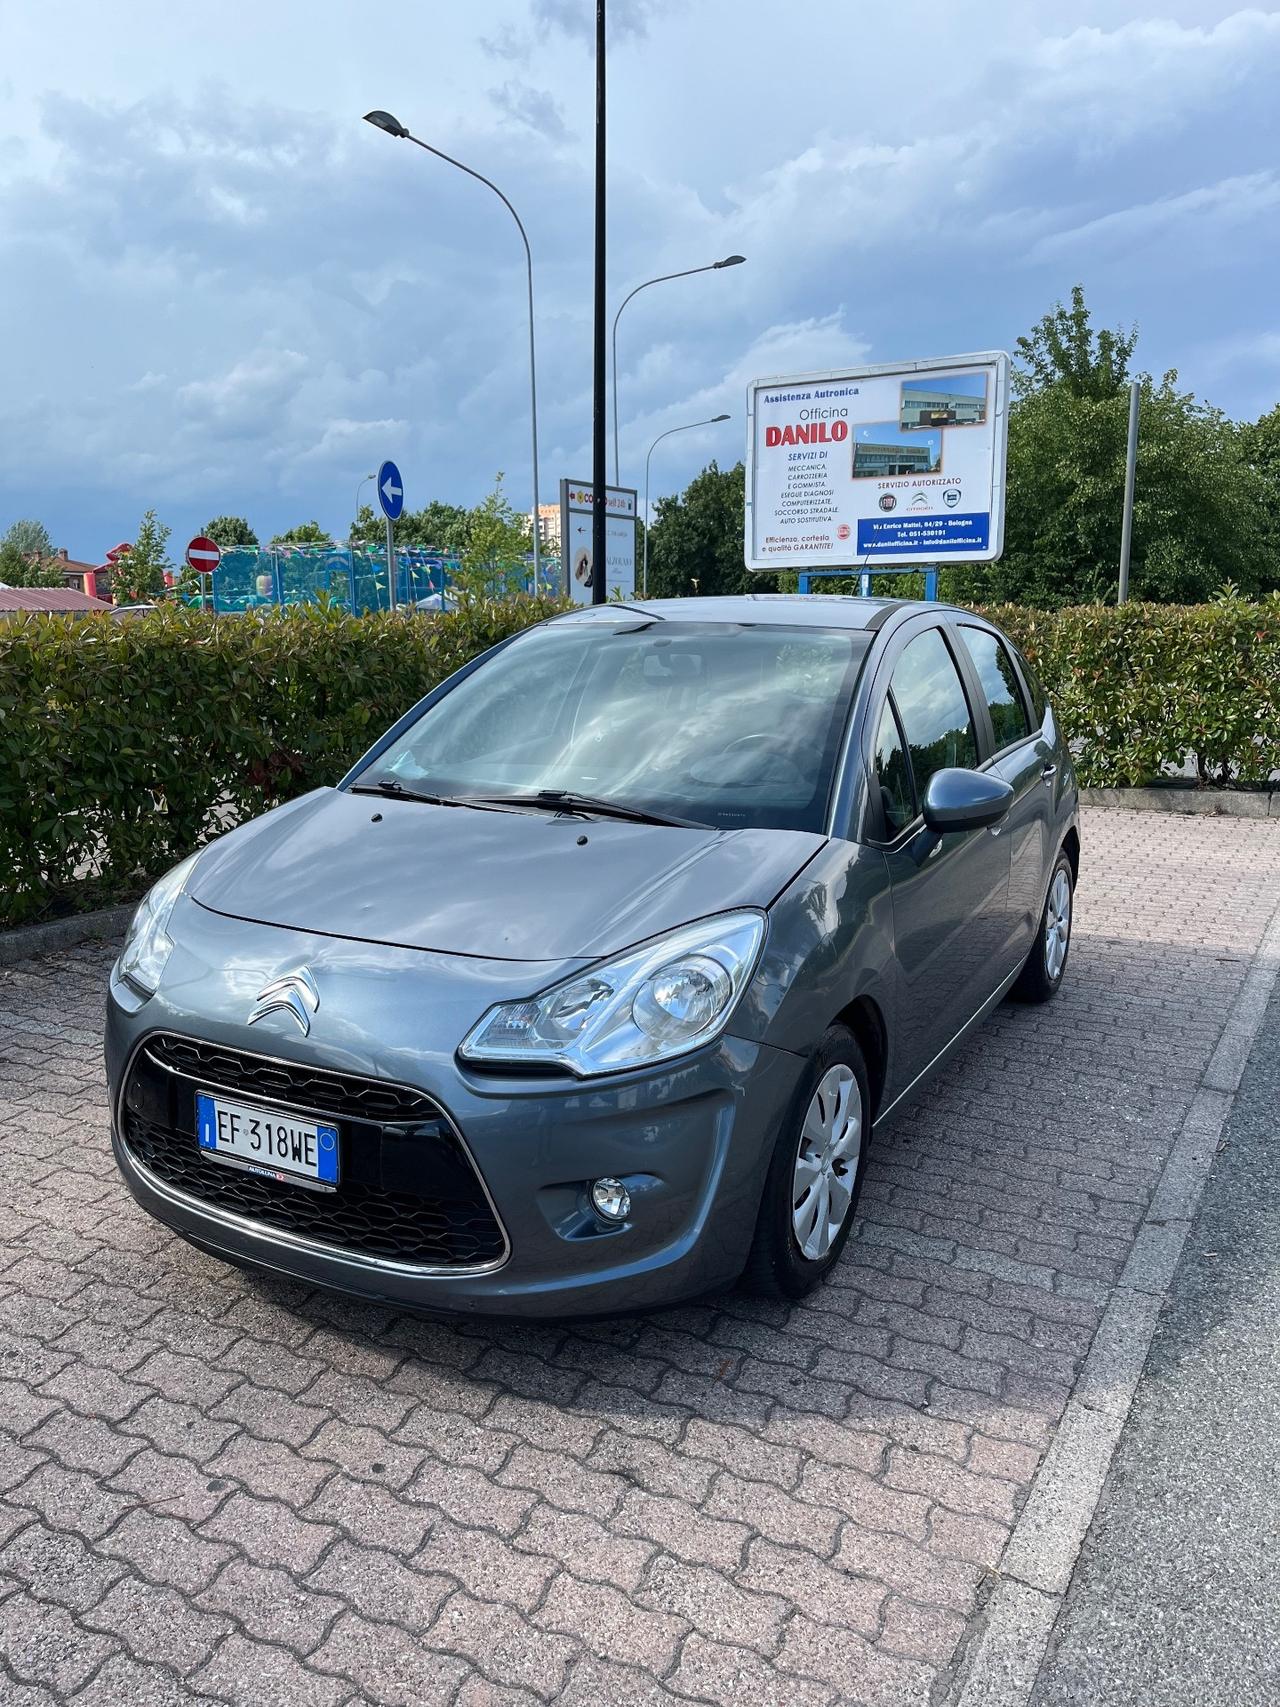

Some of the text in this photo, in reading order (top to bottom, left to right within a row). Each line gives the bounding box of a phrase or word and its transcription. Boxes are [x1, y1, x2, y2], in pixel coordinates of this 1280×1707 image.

[764, 387, 859, 404] Assistenza Autronica
[800, 407, 848, 420] Officina
[766, 420, 848, 447] DANILO
[788, 450, 828, 461] SERVIZI DI
[788, 472, 828, 480] CARROZZERIA
[912, 477, 962, 487] AUTORIZZATO
[803, 489, 834, 497] DIAGNOSI
[774, 509, 808, 517] SOCCORSO
[780, 517, 796, 525] AUTO
